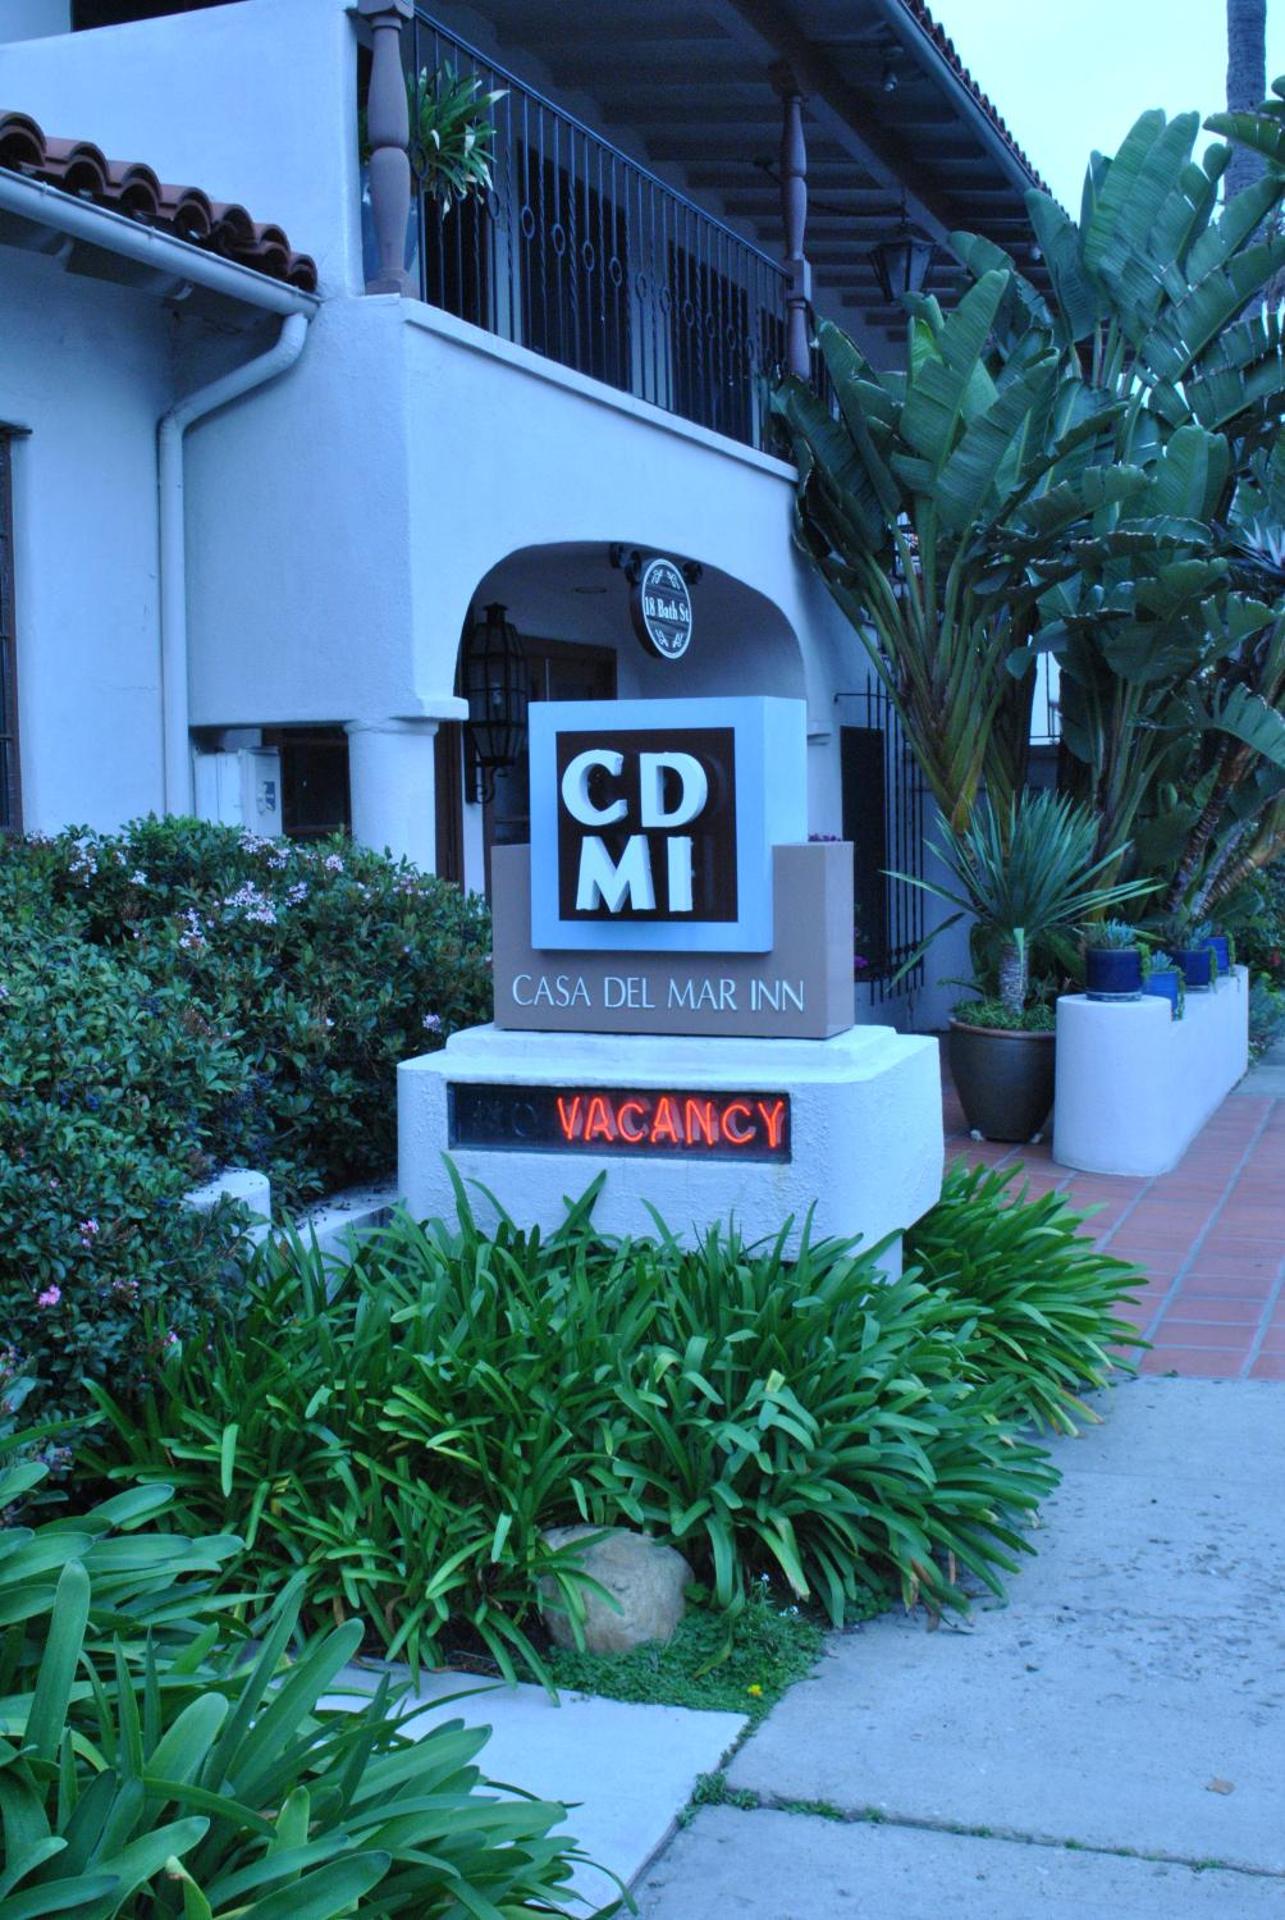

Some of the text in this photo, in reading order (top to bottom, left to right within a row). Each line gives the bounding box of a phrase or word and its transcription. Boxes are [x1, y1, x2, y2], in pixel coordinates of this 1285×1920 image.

[645, 597, 690, 622] 18 Bath St
[561, 749, 708, 827] CD
[576, 834, 694, 913] MI
[512, 974, 804, 1012] CASA DEL MAR INN
[557, 1097, 785, 1148] VACANCY
